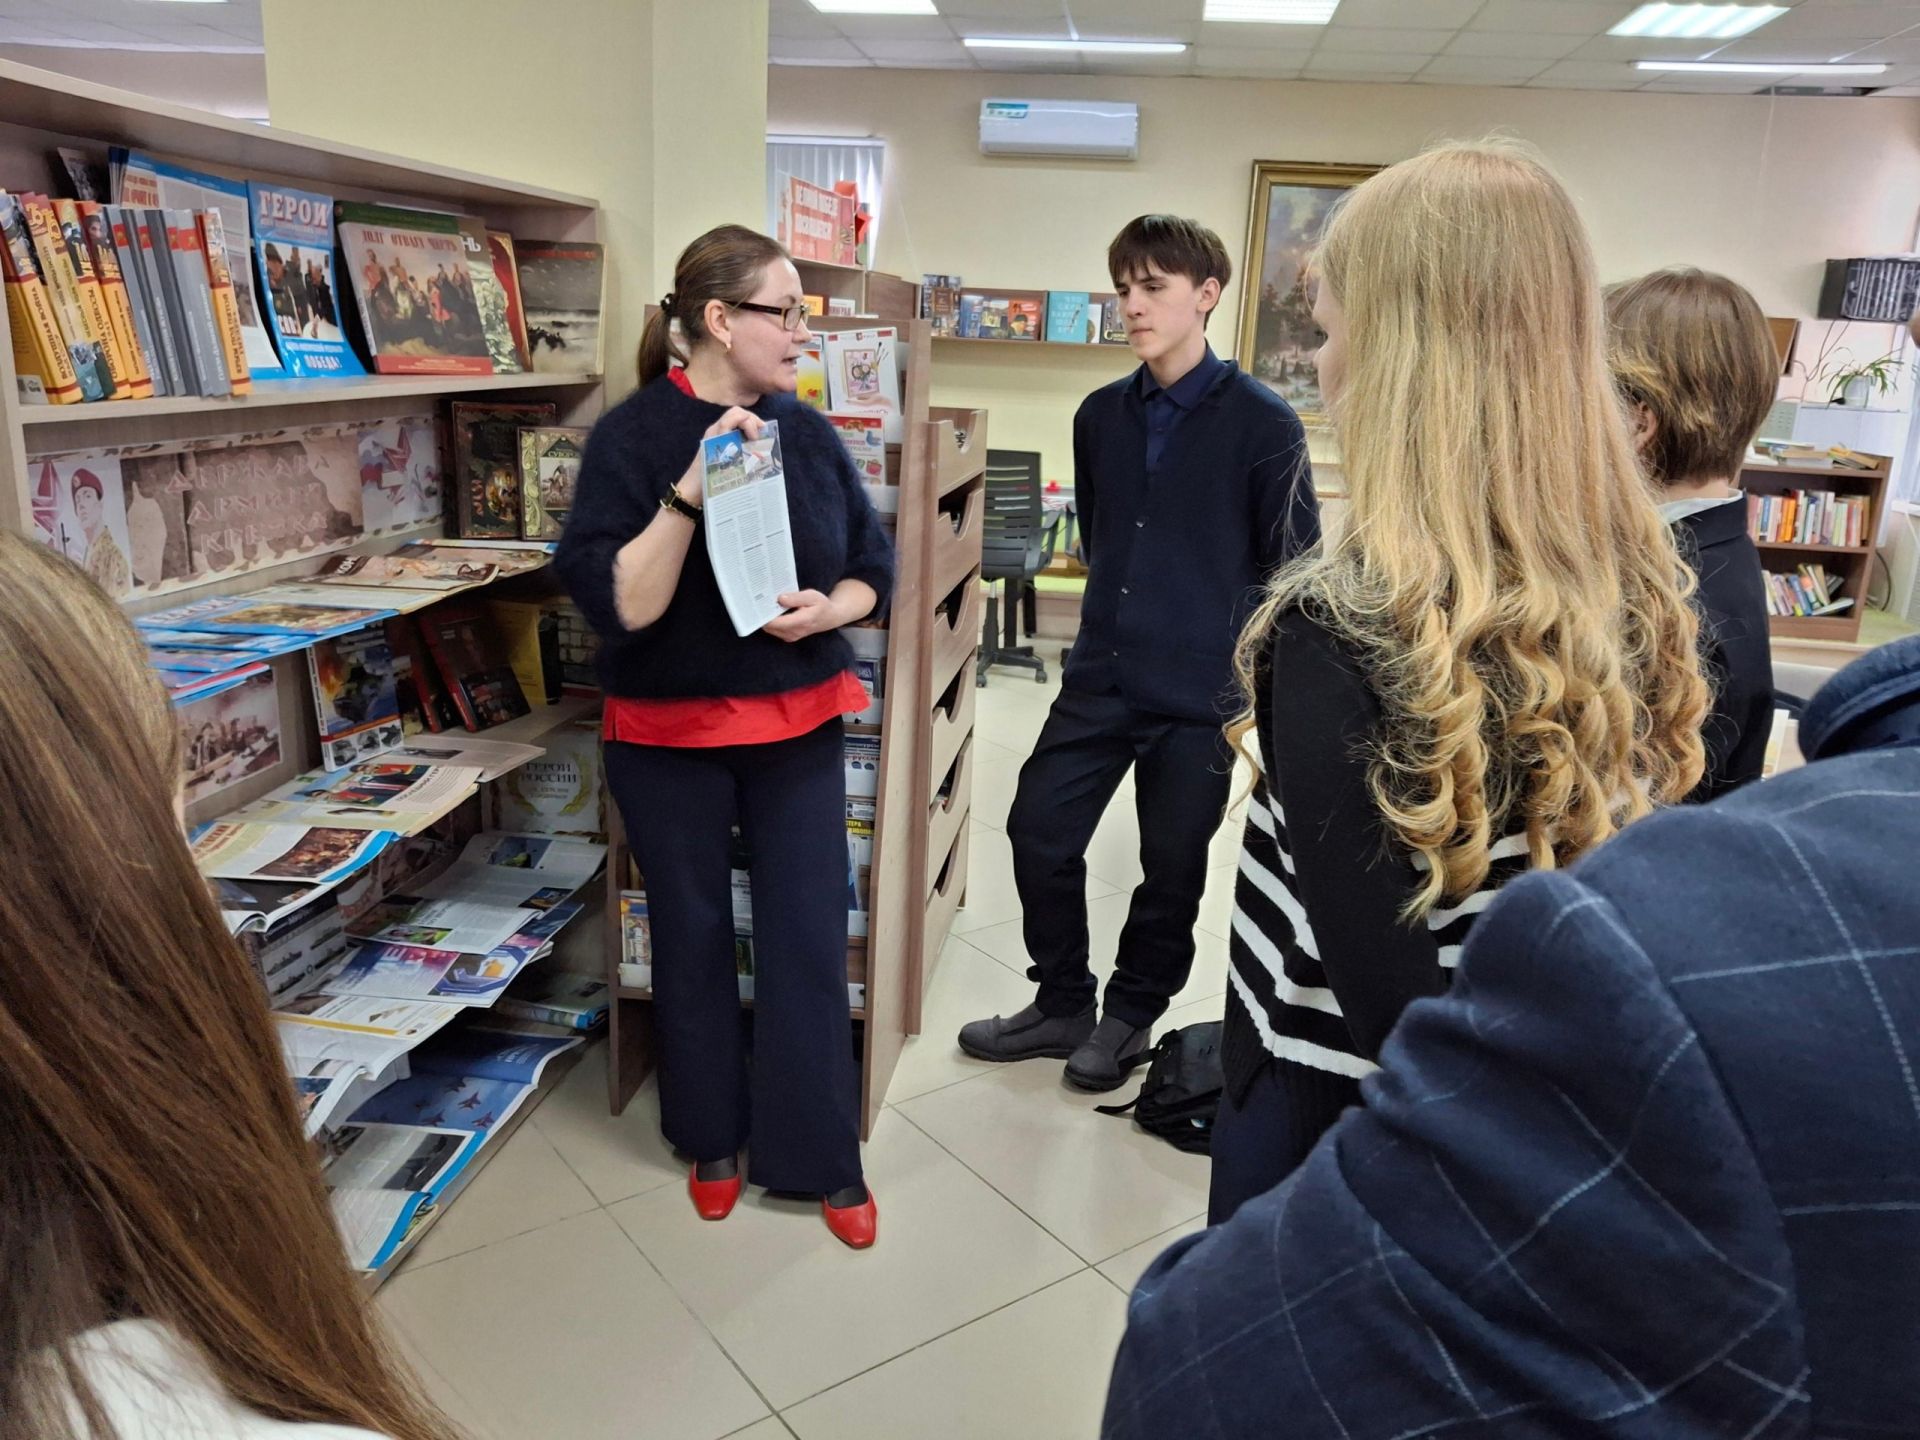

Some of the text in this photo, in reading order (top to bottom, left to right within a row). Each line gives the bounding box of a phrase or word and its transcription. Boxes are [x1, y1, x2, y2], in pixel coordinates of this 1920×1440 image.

[258, 190, 329, 229] ГЕРОИ
[30, 286, 46, 321] ВОЙНА
[43, 321, 68, 379] ВОЗДУШНАЯ
[99, 331, 118, 379] ОБОРОНА
[548, 450, 577, 458] СУВОРО
[520, 773, 577, 784] РОССИИ
[526, 762, 571, 773] ГЕРОИ
